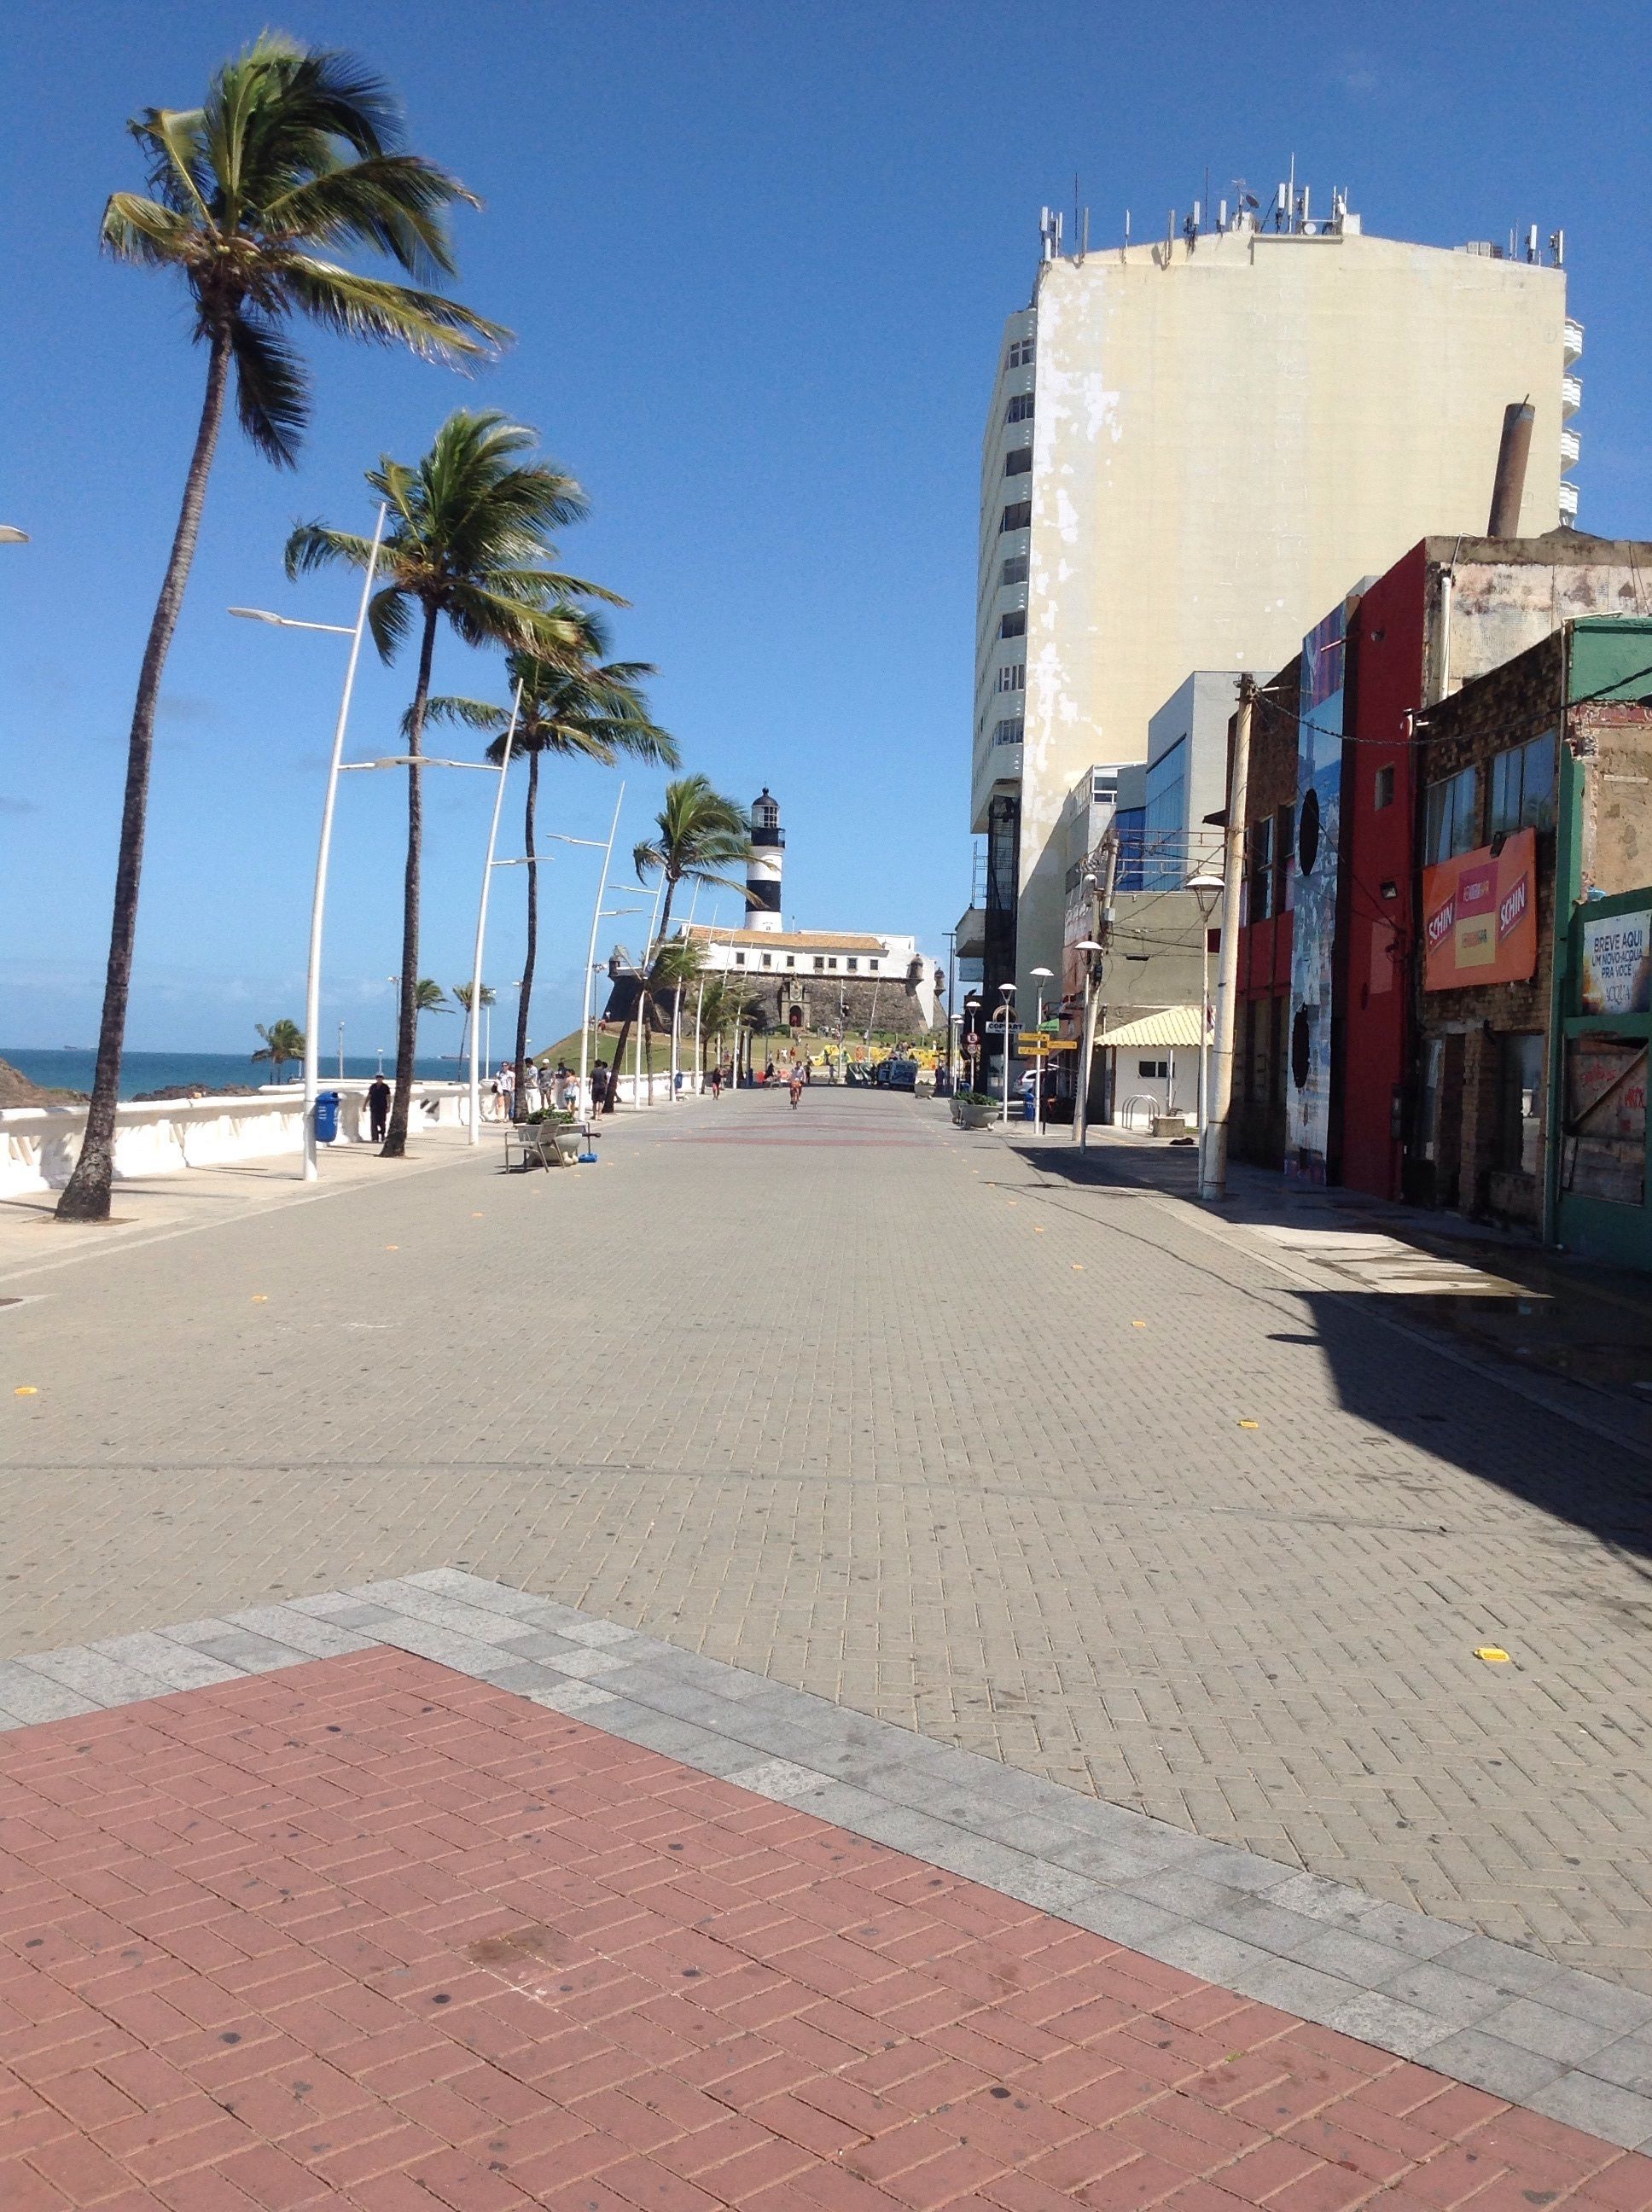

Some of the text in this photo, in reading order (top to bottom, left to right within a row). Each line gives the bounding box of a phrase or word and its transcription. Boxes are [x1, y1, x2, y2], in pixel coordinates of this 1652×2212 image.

[1500, 882, 1526, 931] SCHIN
[1428, 902, 1453, 945] SCHIN
[1594, 929, 1643, 952] BREVE AQUI
[1602, 952, 1620, 965] NOVO
[1602, 966, 1614, 979] PRA
